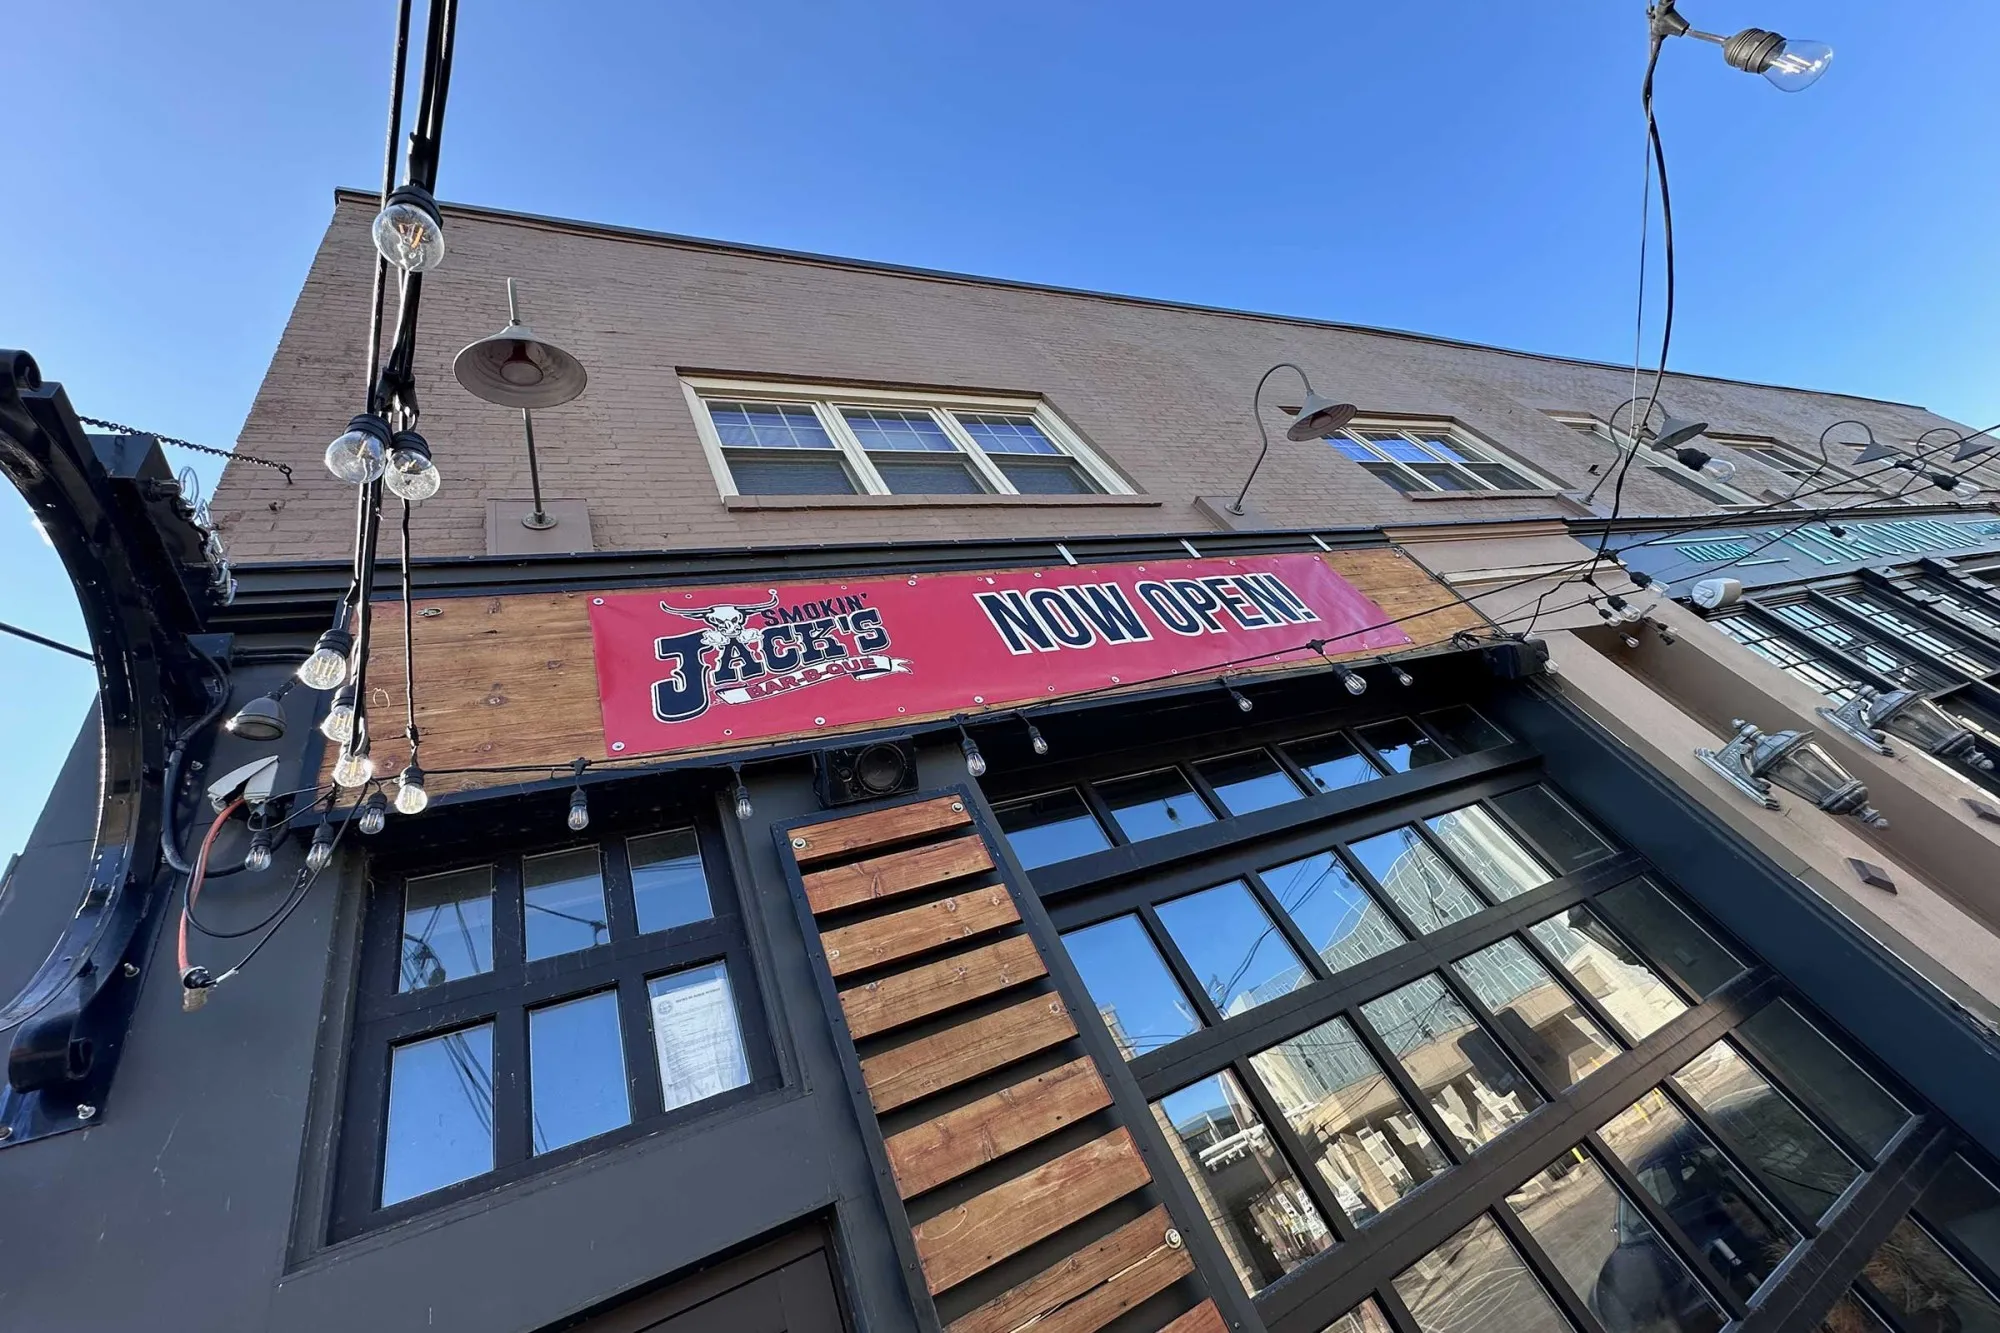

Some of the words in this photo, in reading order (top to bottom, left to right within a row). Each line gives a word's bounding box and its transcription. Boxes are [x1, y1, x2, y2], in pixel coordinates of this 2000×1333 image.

[1675, 543, 1758, 562] ITALIAN
[764, 592, 868, 627] SMOKIN'
[974, 582, 1154, 656] NOW
[1134, 572, 1322, 637] OPEN!
[651, 607, 891, 723] JACK'S
[746, 657, 878, 699] BAR-B-QUE
